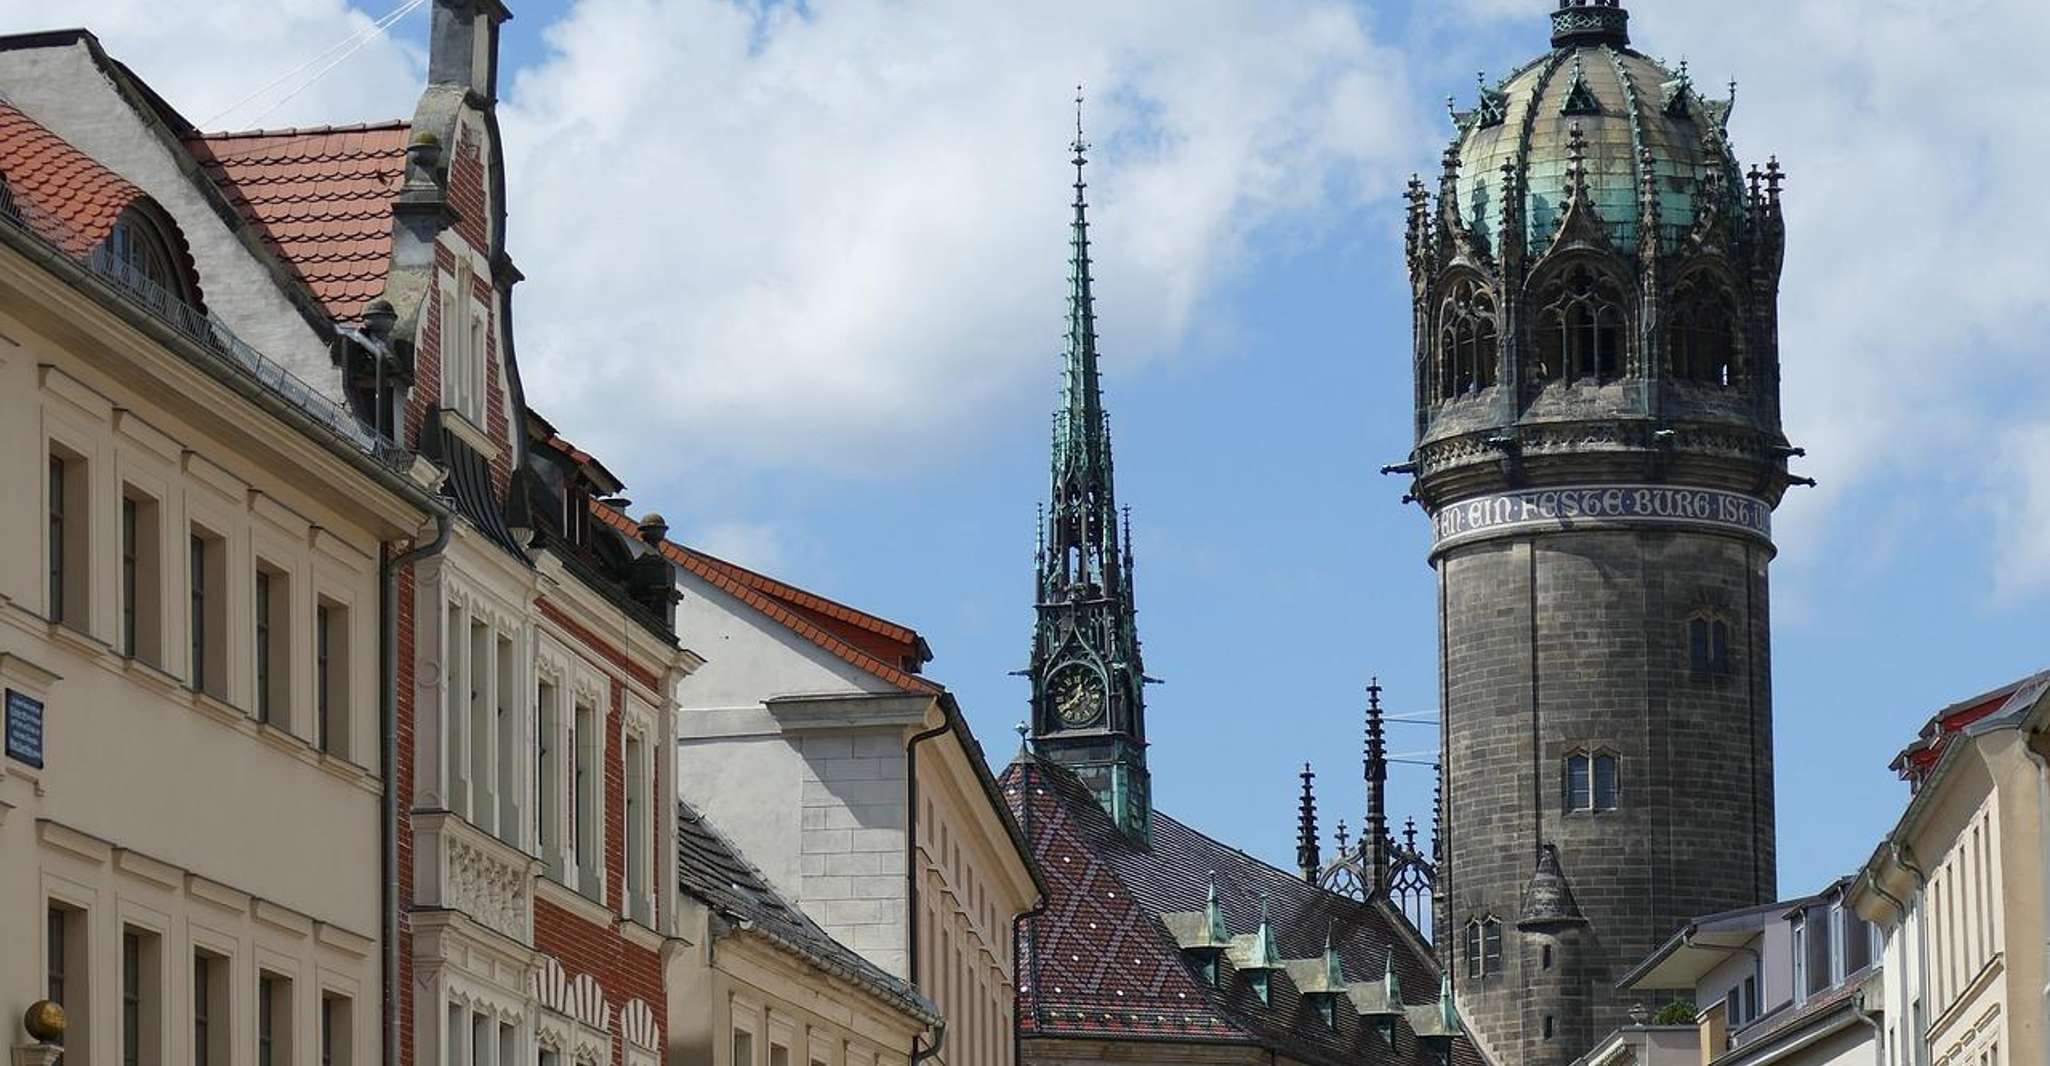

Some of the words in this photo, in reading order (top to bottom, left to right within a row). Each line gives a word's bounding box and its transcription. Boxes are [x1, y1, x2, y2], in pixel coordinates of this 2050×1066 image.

[1468, 496, 1512, 528] EIN
[1520, 489, 1625, 521] FESTE
[1632, 489, 1710, 518] BURG
[1718, 495, 1749, 525] IST
